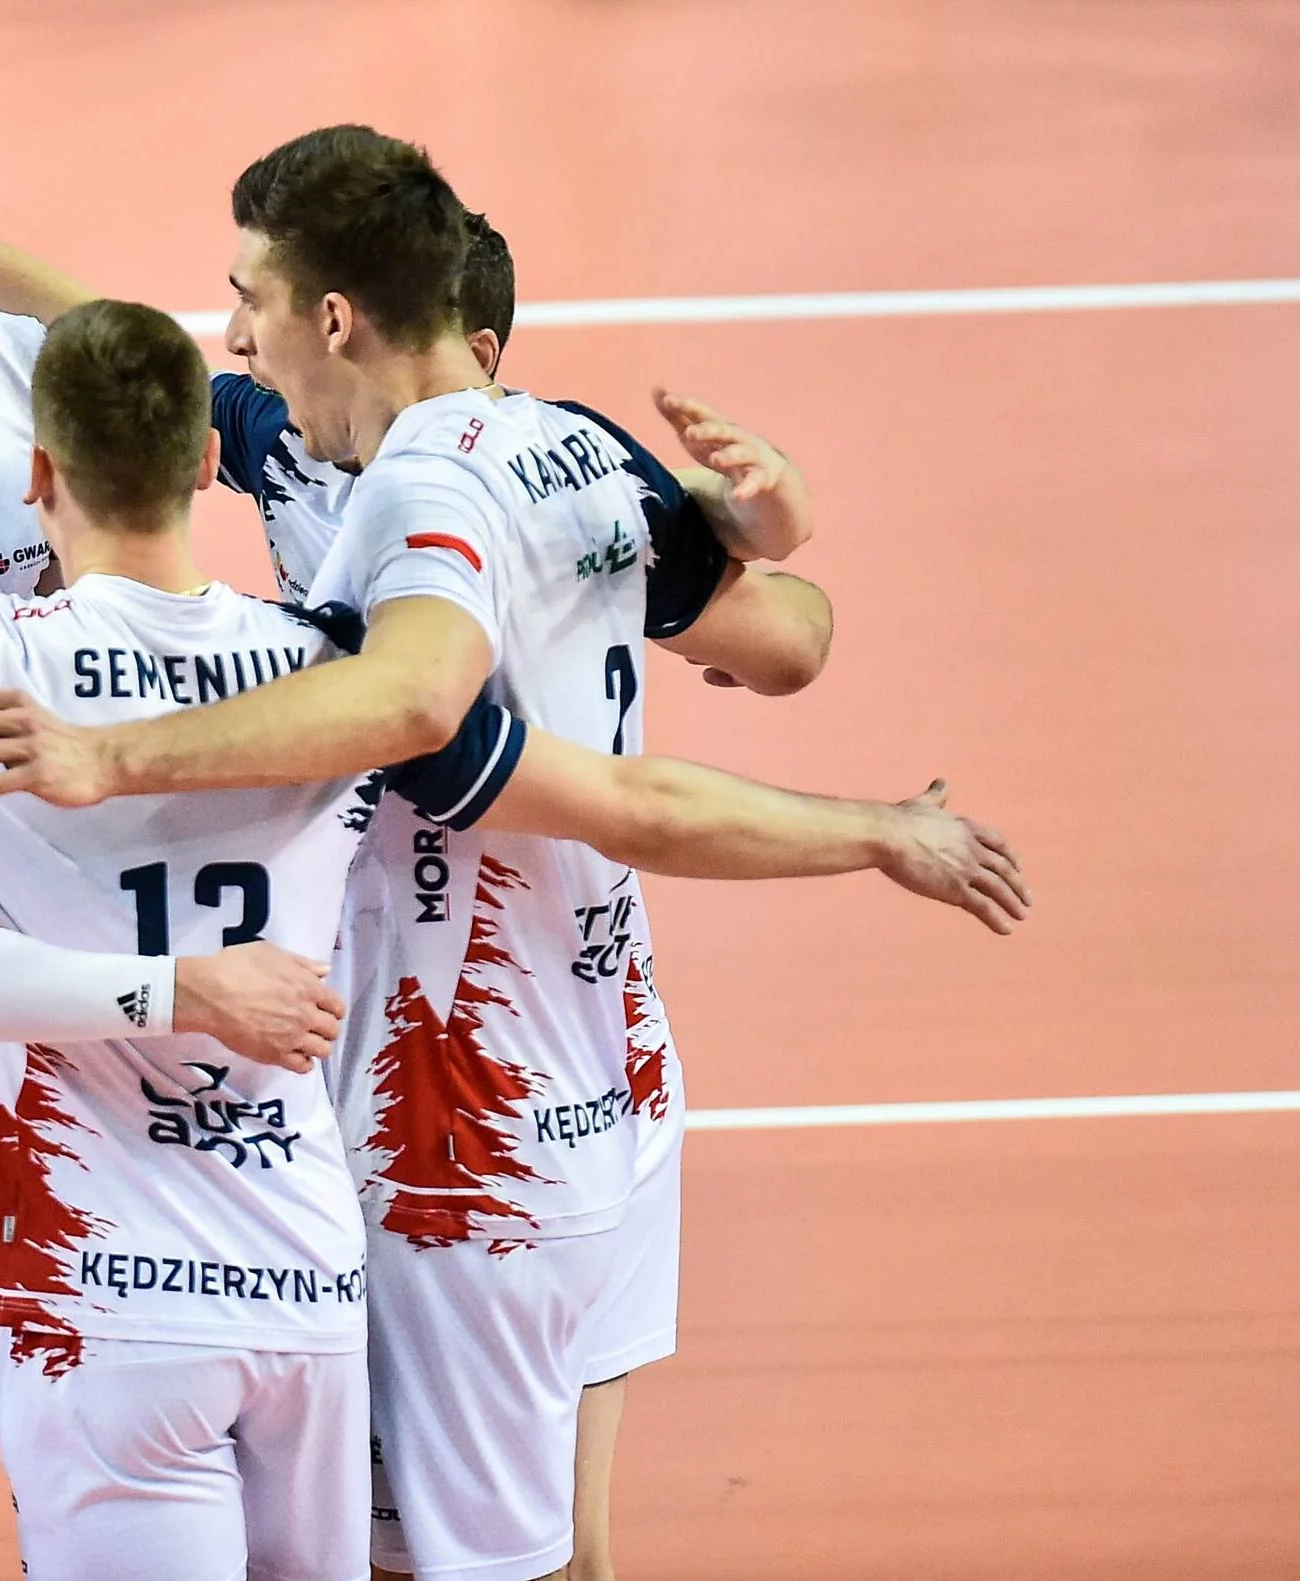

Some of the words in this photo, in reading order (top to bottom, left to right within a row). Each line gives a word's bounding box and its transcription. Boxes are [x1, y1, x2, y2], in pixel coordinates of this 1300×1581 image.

[119, 860, 271, 956] 13
[413, 828, 450, 923] MOR
[81, 1251, 367, 1304] KĘDZIERZYN-KO
